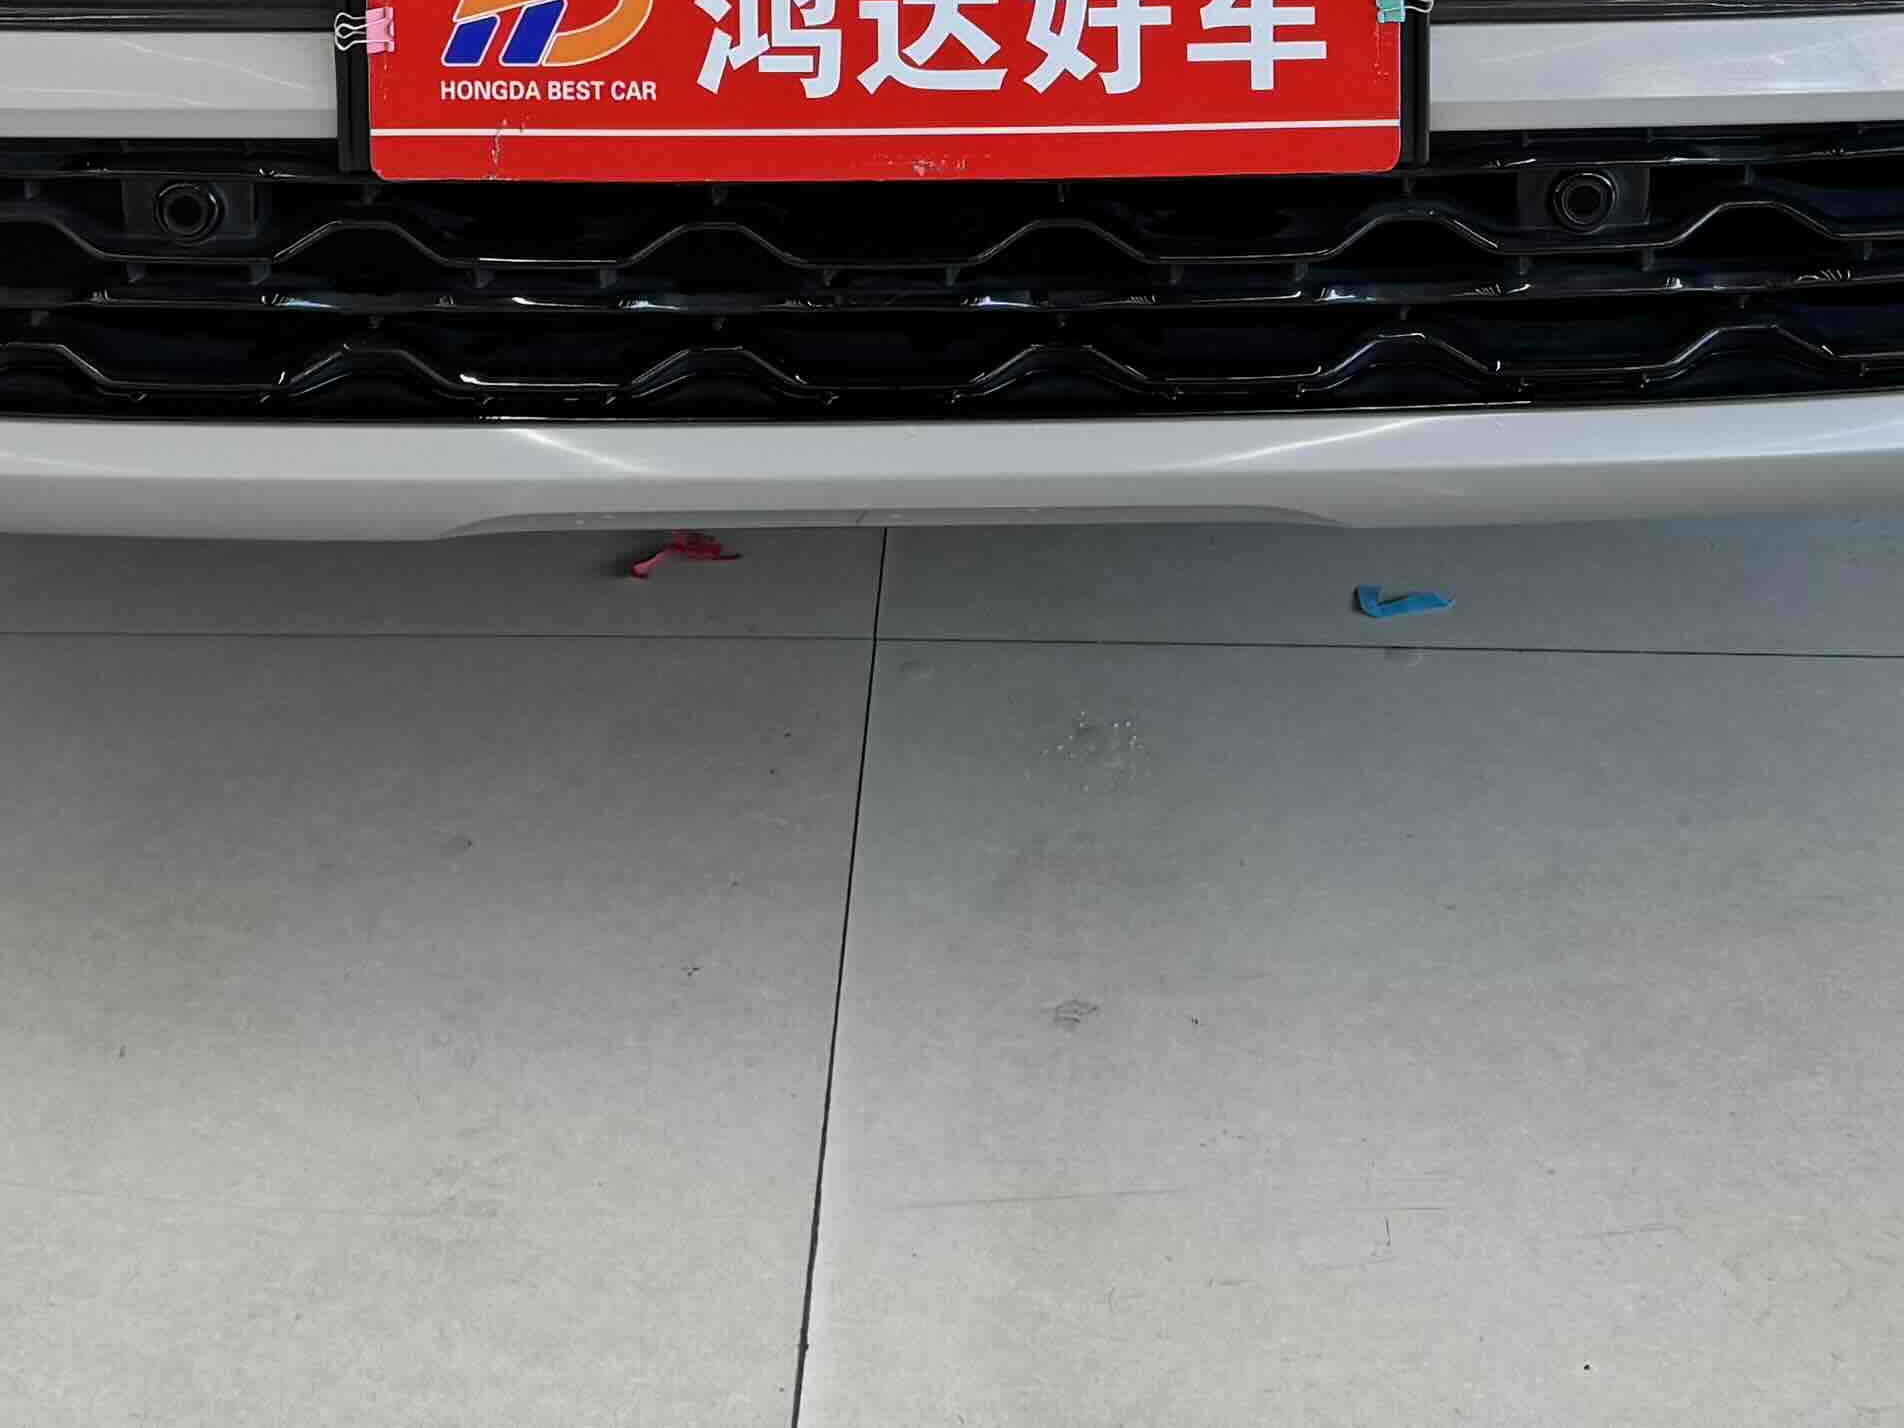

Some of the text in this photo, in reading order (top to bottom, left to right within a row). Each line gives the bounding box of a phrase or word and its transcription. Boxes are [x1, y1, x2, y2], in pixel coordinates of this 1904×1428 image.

[440, 80, 657, 101] HONGDA BEST CAR
